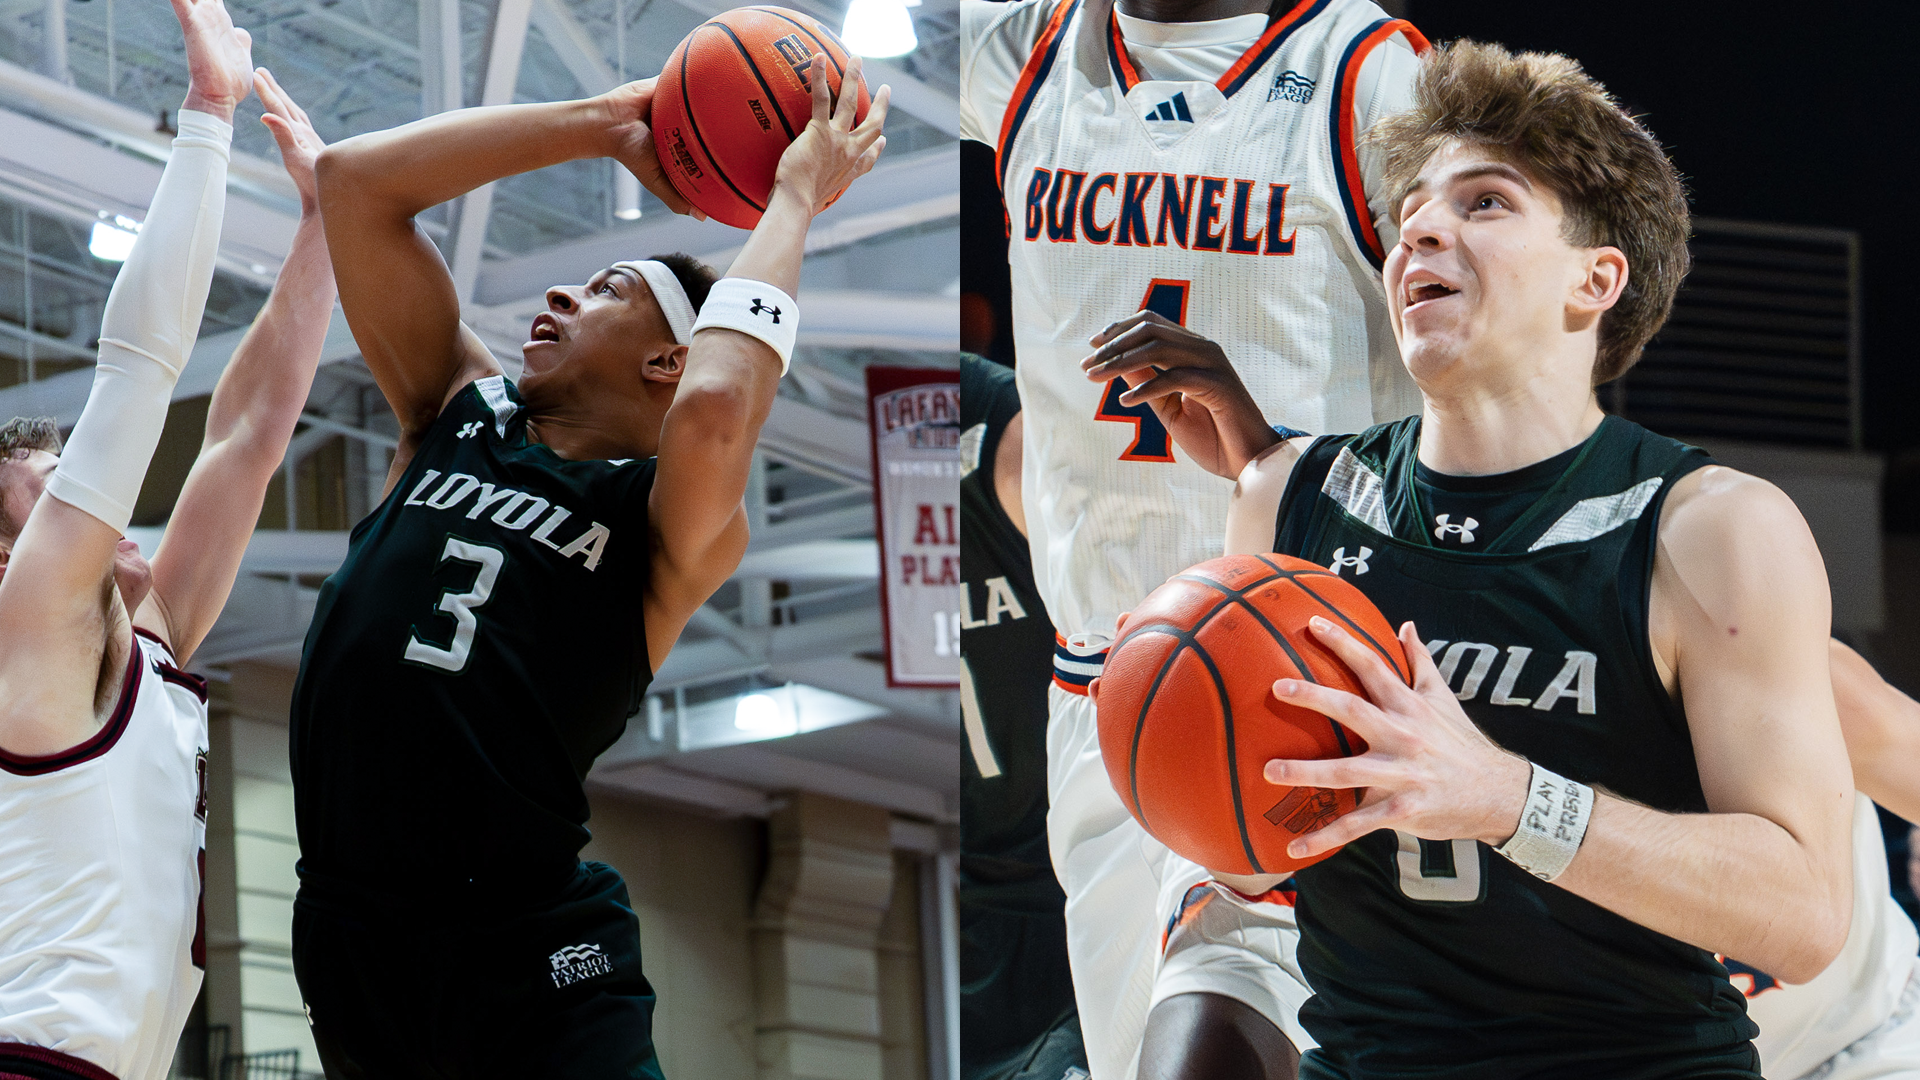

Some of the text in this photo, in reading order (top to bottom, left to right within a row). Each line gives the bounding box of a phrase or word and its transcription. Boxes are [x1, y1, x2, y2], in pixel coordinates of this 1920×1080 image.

[1266, 93, 1313, 104] LEAGU
[1269, 85, 1314, 98] PATRIO
[1025, 167, 1297, 256] BUCKNELL
[1094, 278, 1191, 464] 4
[404, 469, 610, 572] LOYOLA
[902, 554, 960, 587] PLA
[403, 536, 505, 673] 3
[1526, 781, 1558, 833] PLAY
[551, 954, 609, 980] PATRIOT
[554, 964, 614, 988] LEAGUE
